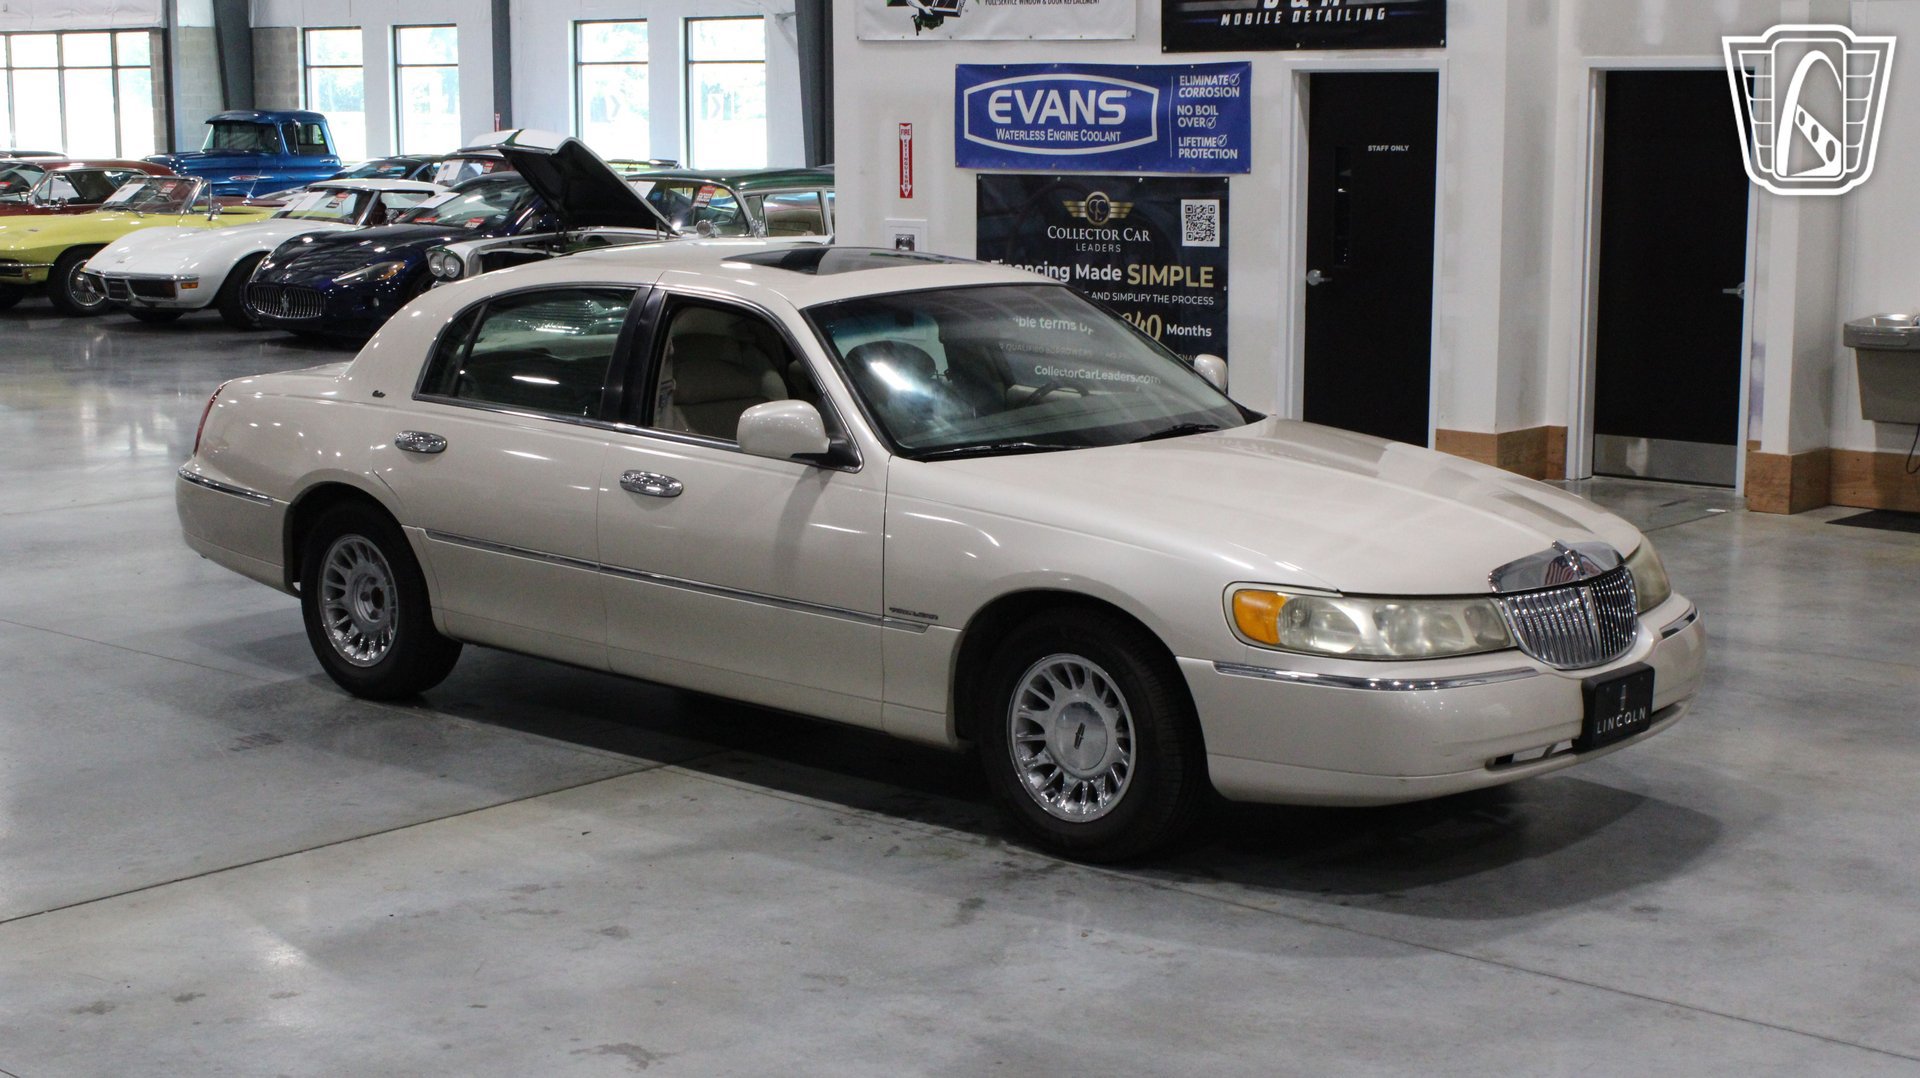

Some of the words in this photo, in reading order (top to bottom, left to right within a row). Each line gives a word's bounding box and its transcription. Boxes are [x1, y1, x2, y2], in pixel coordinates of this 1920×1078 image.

[1220, 11, 1282, 26] MOBILE
[1292, 7, 1386, 23] DETAILING
[1179, 75, 1229, 86] ELIMINATE
[1178, 87, 1240, 98] CORROSION
[988, 89, 1127, 125] EVANS
[1176, 105, 1193, 115] NO
[1195, 105, 1219, 116] BOIL
[1177, 117, 1206, 127] OVER
[996, 128, 1046, 141] WATERLESS
[1047, 128, 1079, 142] ENGINE
[1080, 129, 1121, 142] COOLANT
[1178, 136, 1217, 147] LIFETIME
[1178, 148, 1238, 159] PROTECTION
[1367, 144, 1389, 152] STAFF
[1390, 144, 1410, 152] ONLY
[1047, 225, 1120, 241] COLLECTOR
[1123, 227, 1151, 242] CAR
[1075, 242, 1121, 253] LEADERS
[1075, 263, 1122, 281] Made
[1127, 264, 1214, 288] SIMPLE
[1091, 292, 1111, 302] AND
[1112, 292, 1152, 303] SIMPLIFY
[1153, 294, 1170, 304] THE
[1171, 294, 1214, 306] PROCESS
[1038, 317, 1077, 331] terms
[1166, 323, 1212, 337] Months
[1034, 365, 1161, 385] CollectorCarLeaders.com
[1596, 706, 1646, 734] LINCOLN
